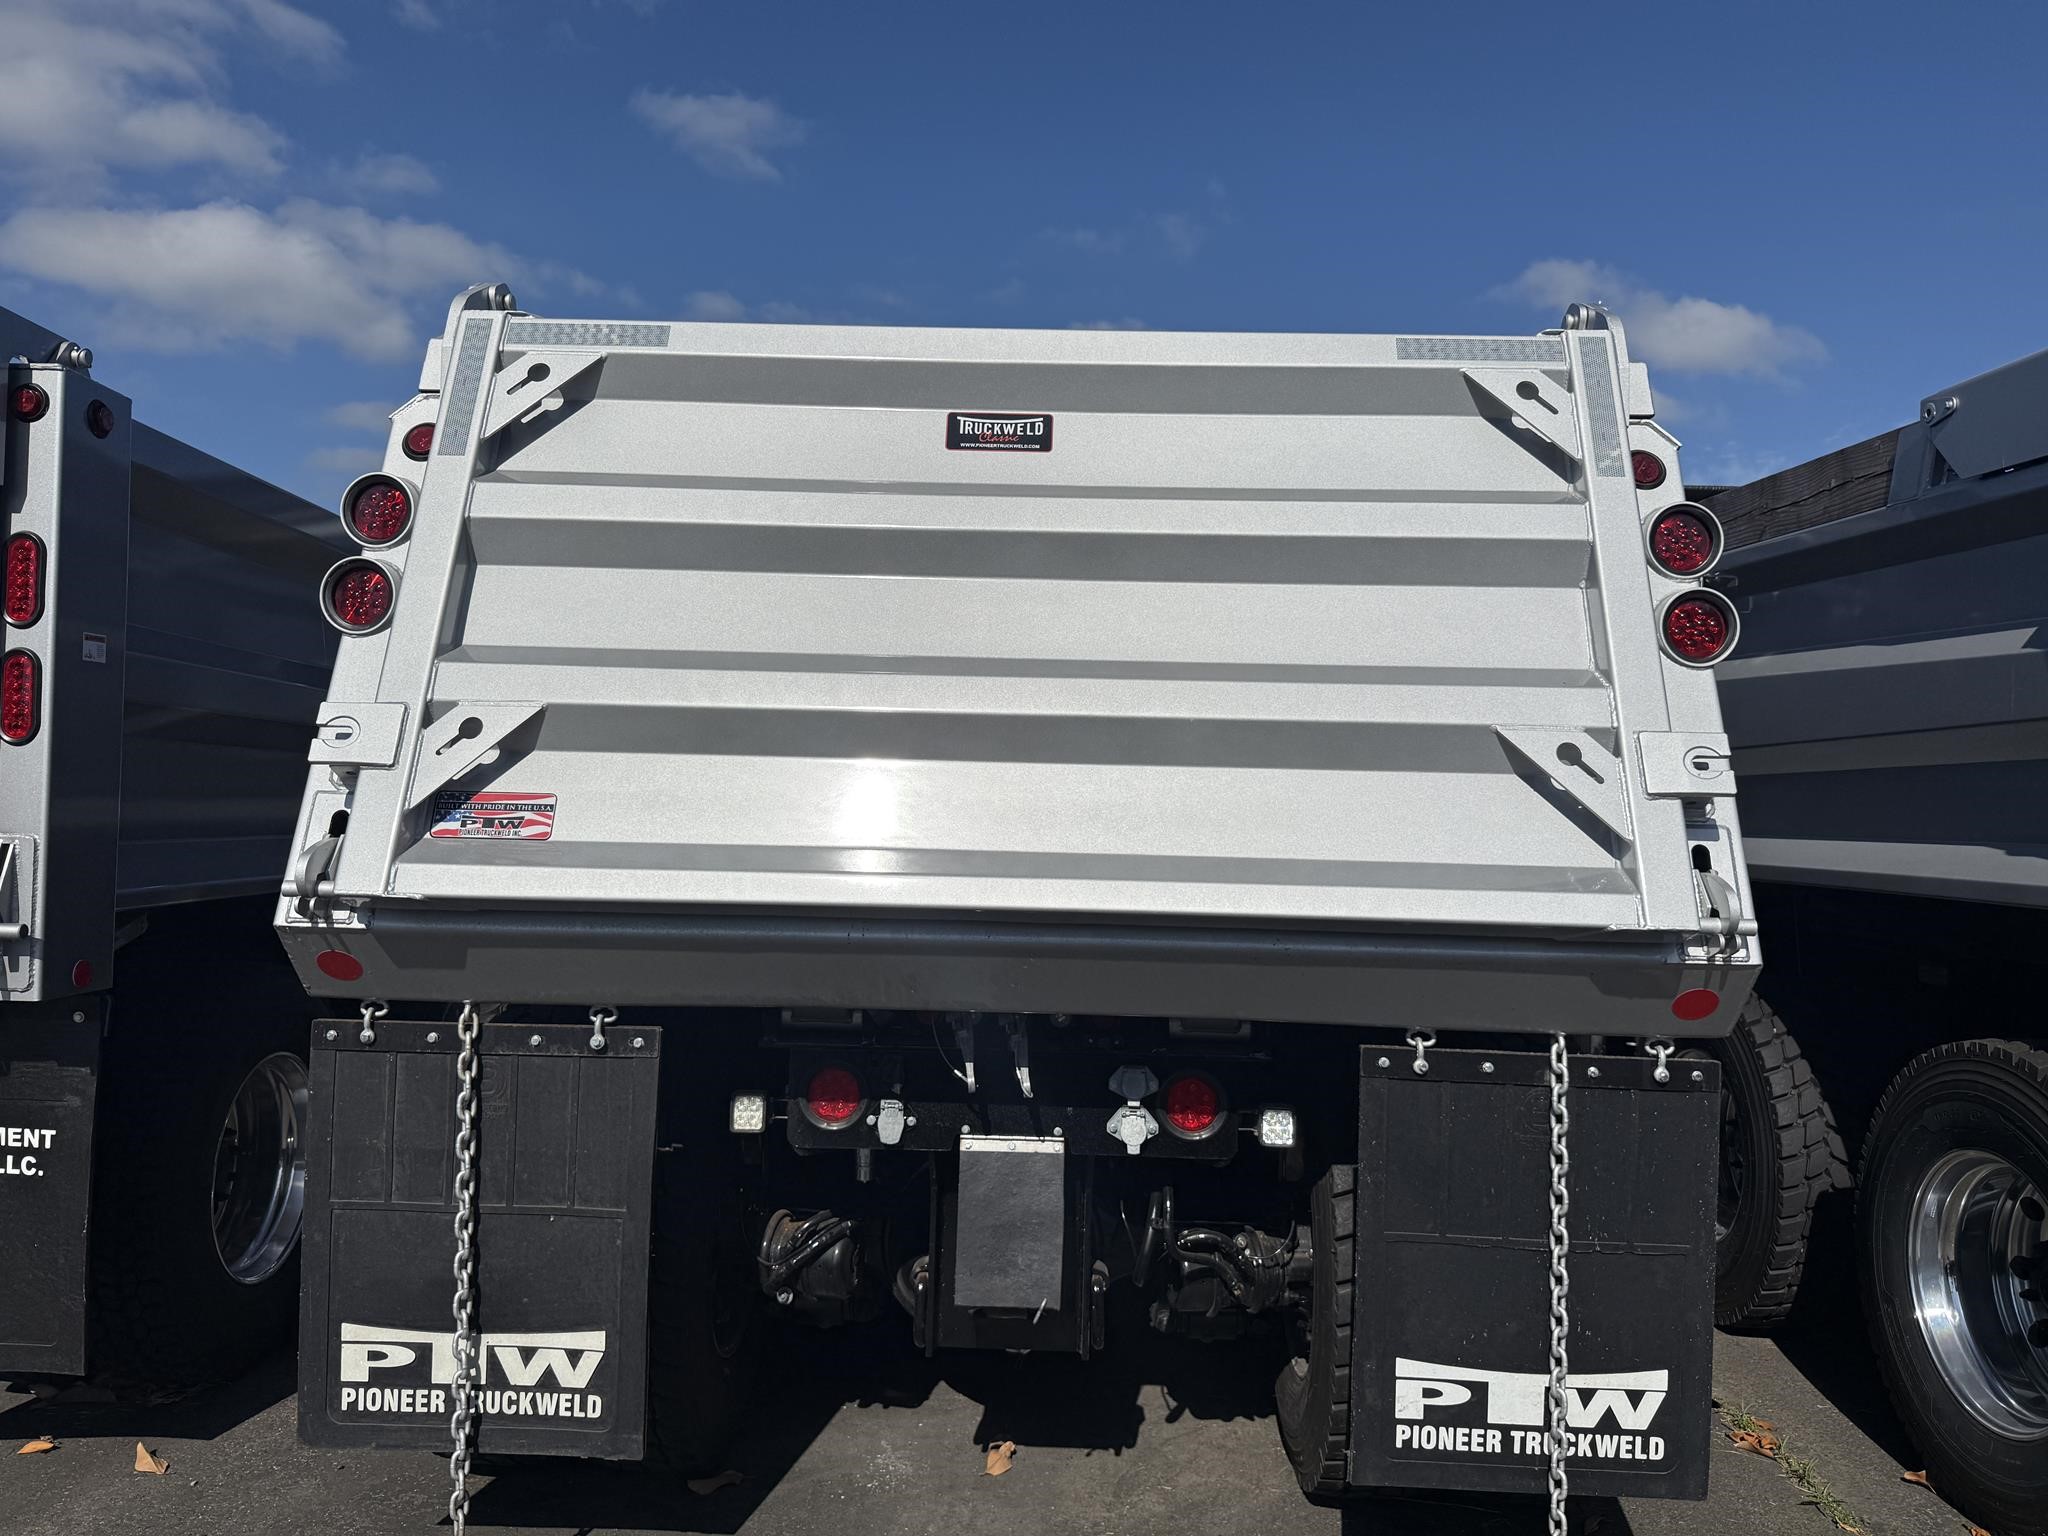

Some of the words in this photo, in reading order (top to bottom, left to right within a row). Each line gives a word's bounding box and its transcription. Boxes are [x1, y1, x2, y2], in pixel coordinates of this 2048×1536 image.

[957, 416, 1043, 435] TRUCKWELD
[979, 432, 1019, 442] Classic
[460, 815, 525, 829] PTW
[482, 829, 511, 837] TRUCKWELD
[341, 1322, 606, 1389] PTW
[341, 1387, 446, 1414] PIONEER
[461, 1390, 602, 1419] RUCKWELD
[1395, 1357, 1669, 1430] PTW
[1395, 1424, 1502, 1453] PIONEER
